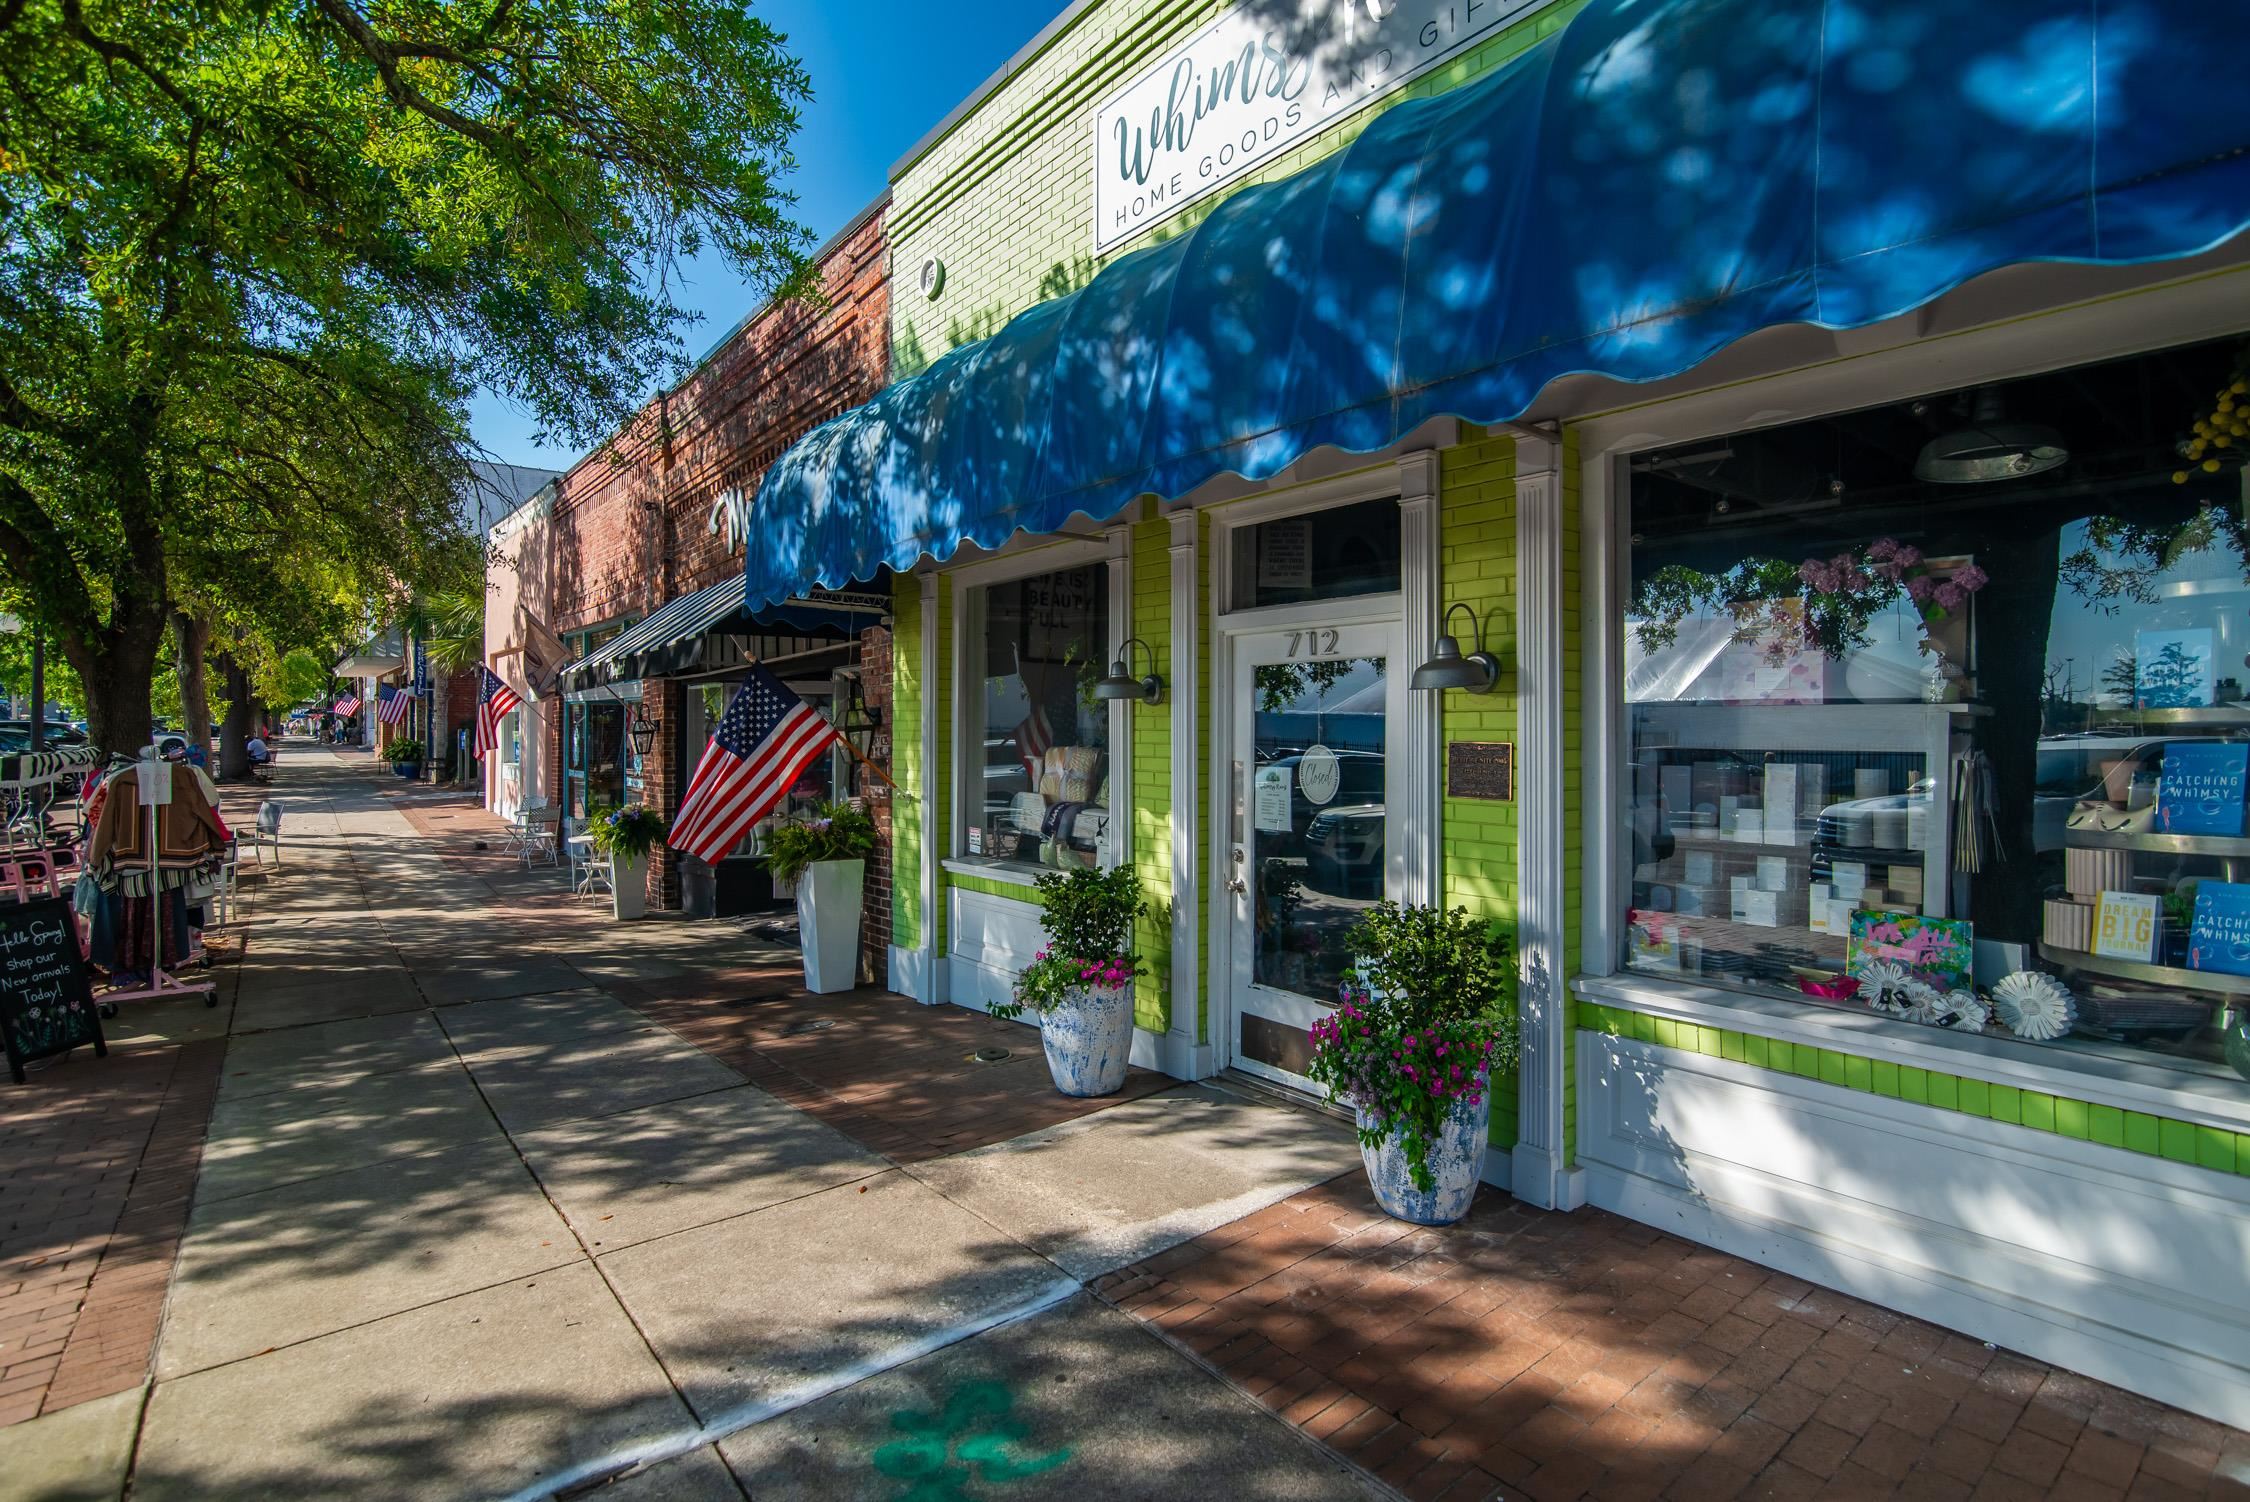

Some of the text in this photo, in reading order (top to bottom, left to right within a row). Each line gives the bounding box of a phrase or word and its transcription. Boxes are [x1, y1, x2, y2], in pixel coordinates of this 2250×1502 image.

[1115, 172, 1182, 228] HOME
[1199, 102, 1301, 178] GOODS
[1322, 48, 1393, 108] AND
[1419, 0, 1507, 47] GIF
[1284, 628, 1341, 658] 712
[2167, 775, 2238, 787] CATCHING
[2172, 788, 2230, 799] WHIMSY
[2104, 903, 2152, 919] DREAM
[2102, 914, 2151, 943] BIG
[1, 976, 28, 993] New
[18, 980, 64, 1005] Today!
